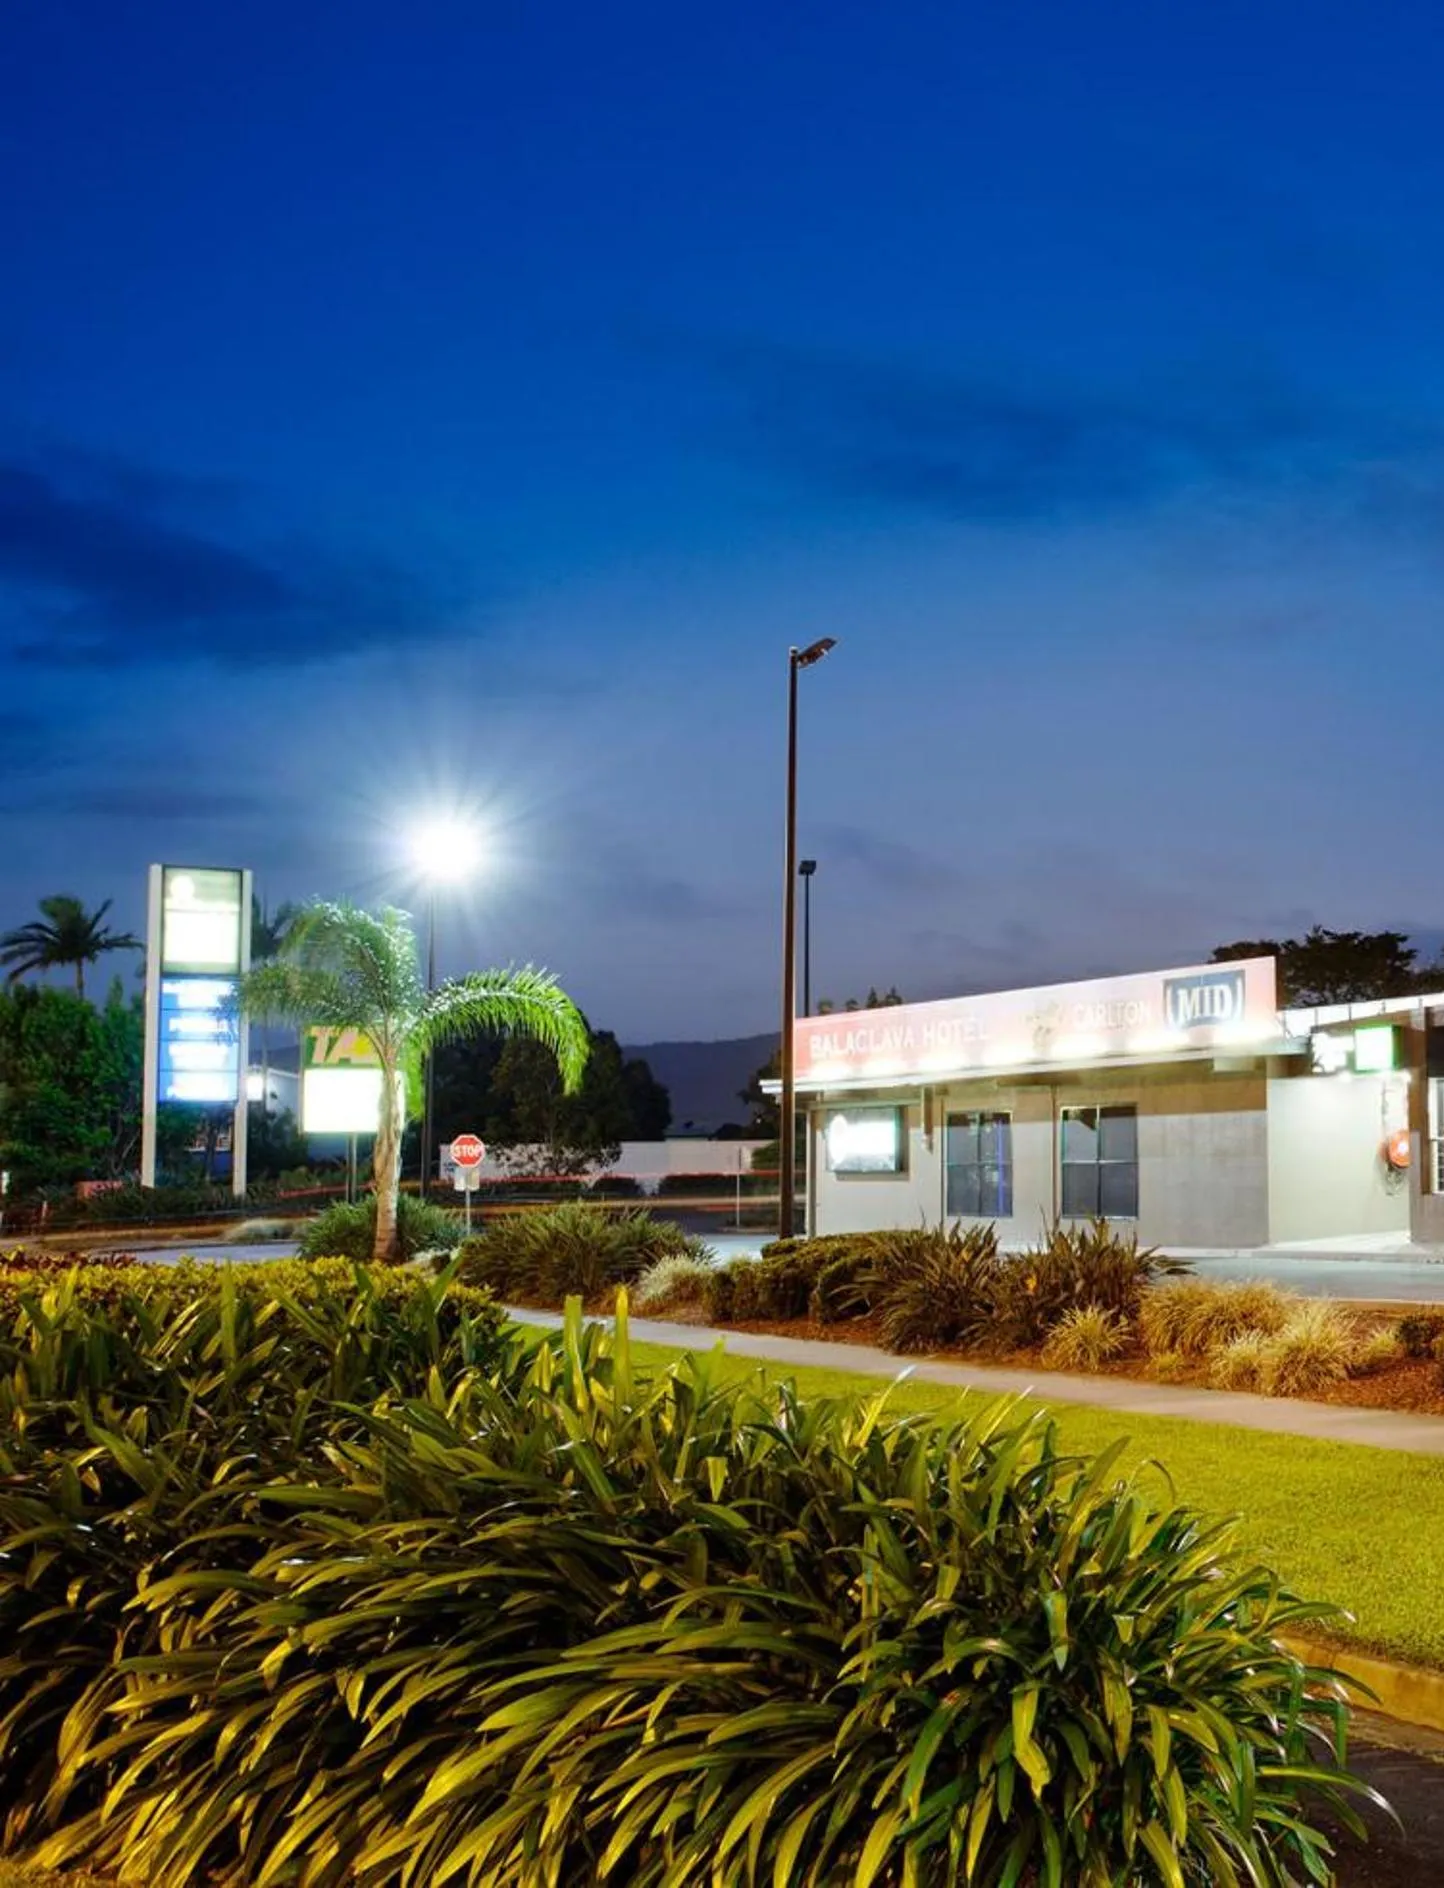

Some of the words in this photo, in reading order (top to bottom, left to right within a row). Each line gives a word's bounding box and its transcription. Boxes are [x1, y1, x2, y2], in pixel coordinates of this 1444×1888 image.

[1177, 984, 1232, 1024] MID
[811, 1024, 914, 1058] BALACLAVA
[923, 1015, 990, 1047] HOTEL
[453, 1144, 483, 1158] STOP
